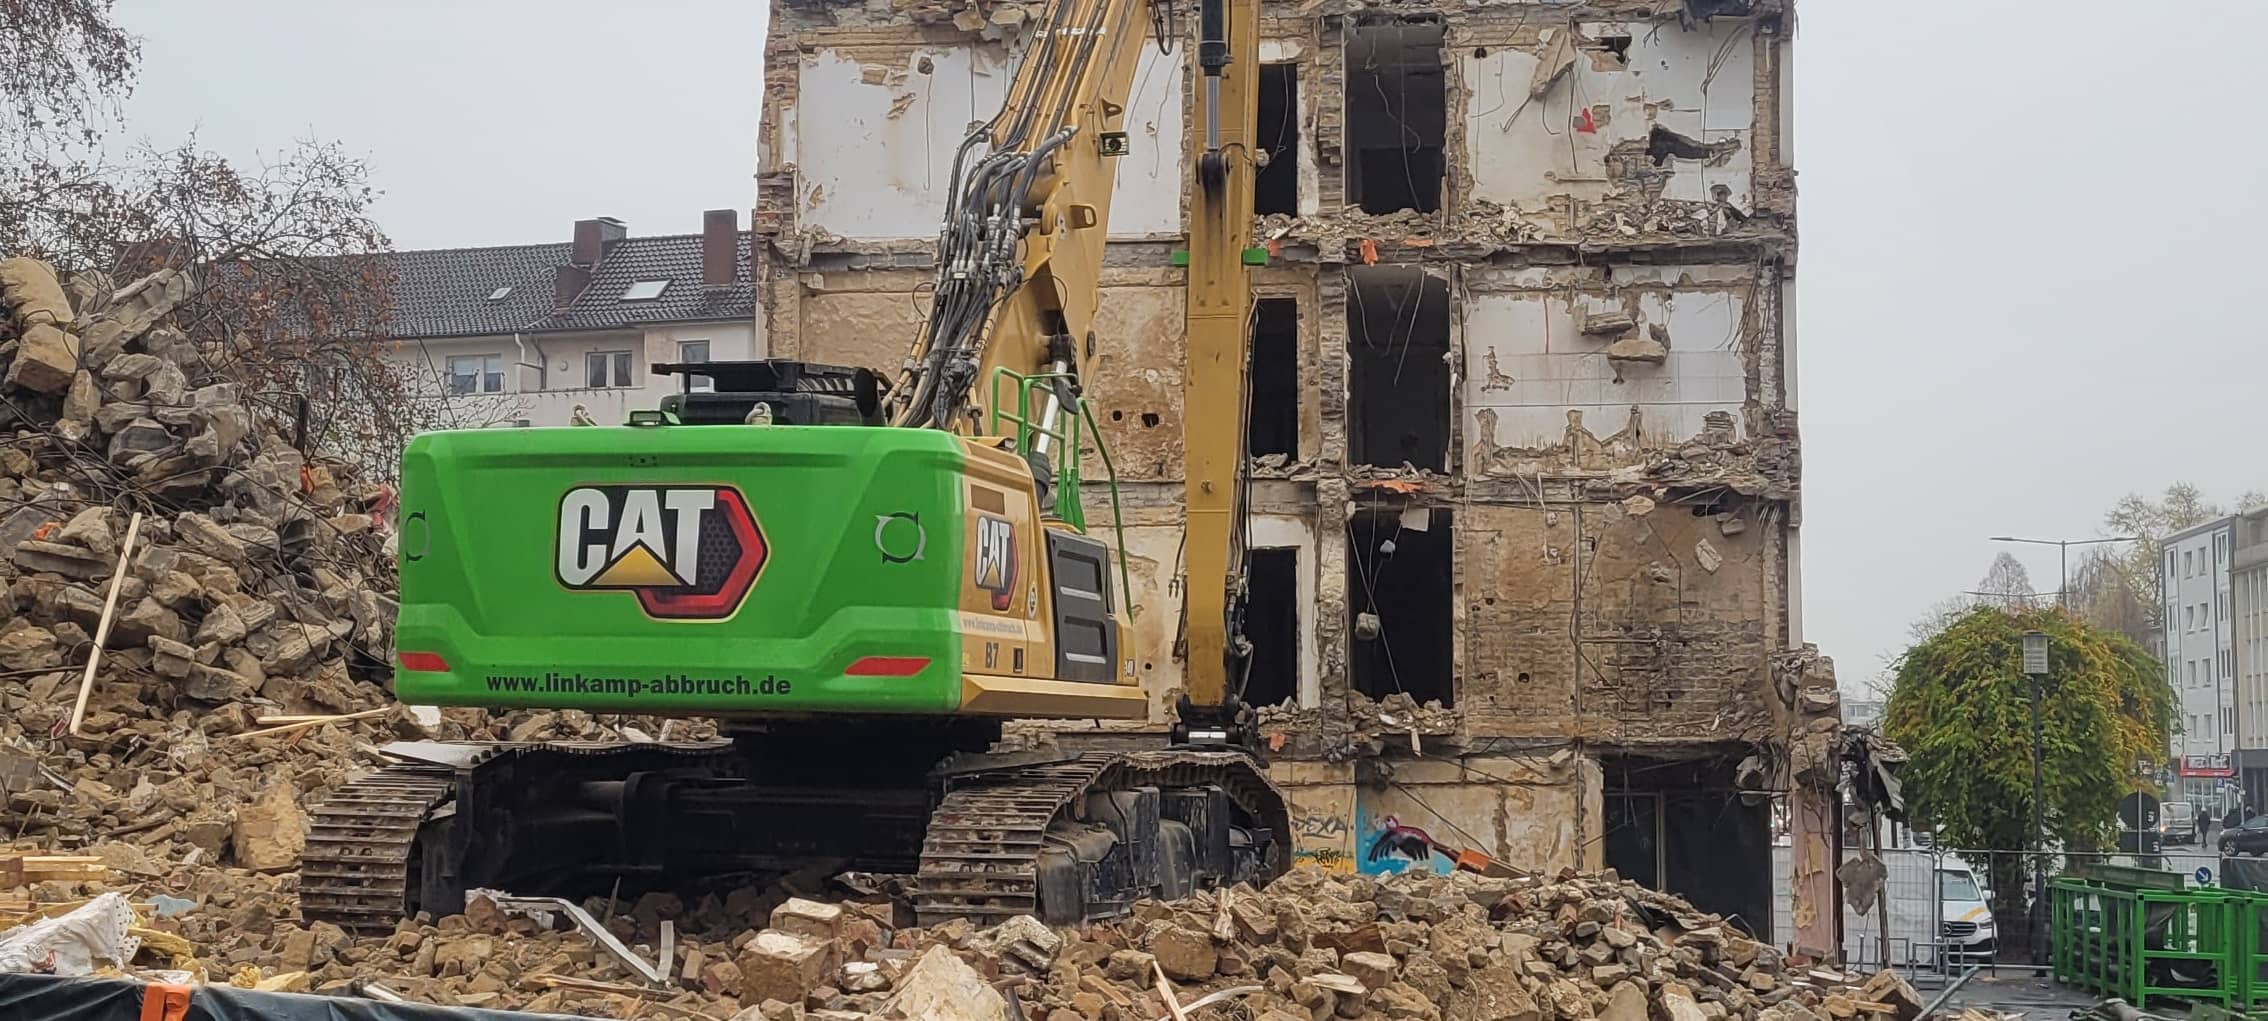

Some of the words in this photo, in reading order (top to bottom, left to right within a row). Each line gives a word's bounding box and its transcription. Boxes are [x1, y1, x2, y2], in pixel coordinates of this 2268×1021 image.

[559, 488, 715, 586] CAT
[976, 516, 1010, 589] CAT
[486, 673, 791, 697] www.linkamp-abbruch.de
